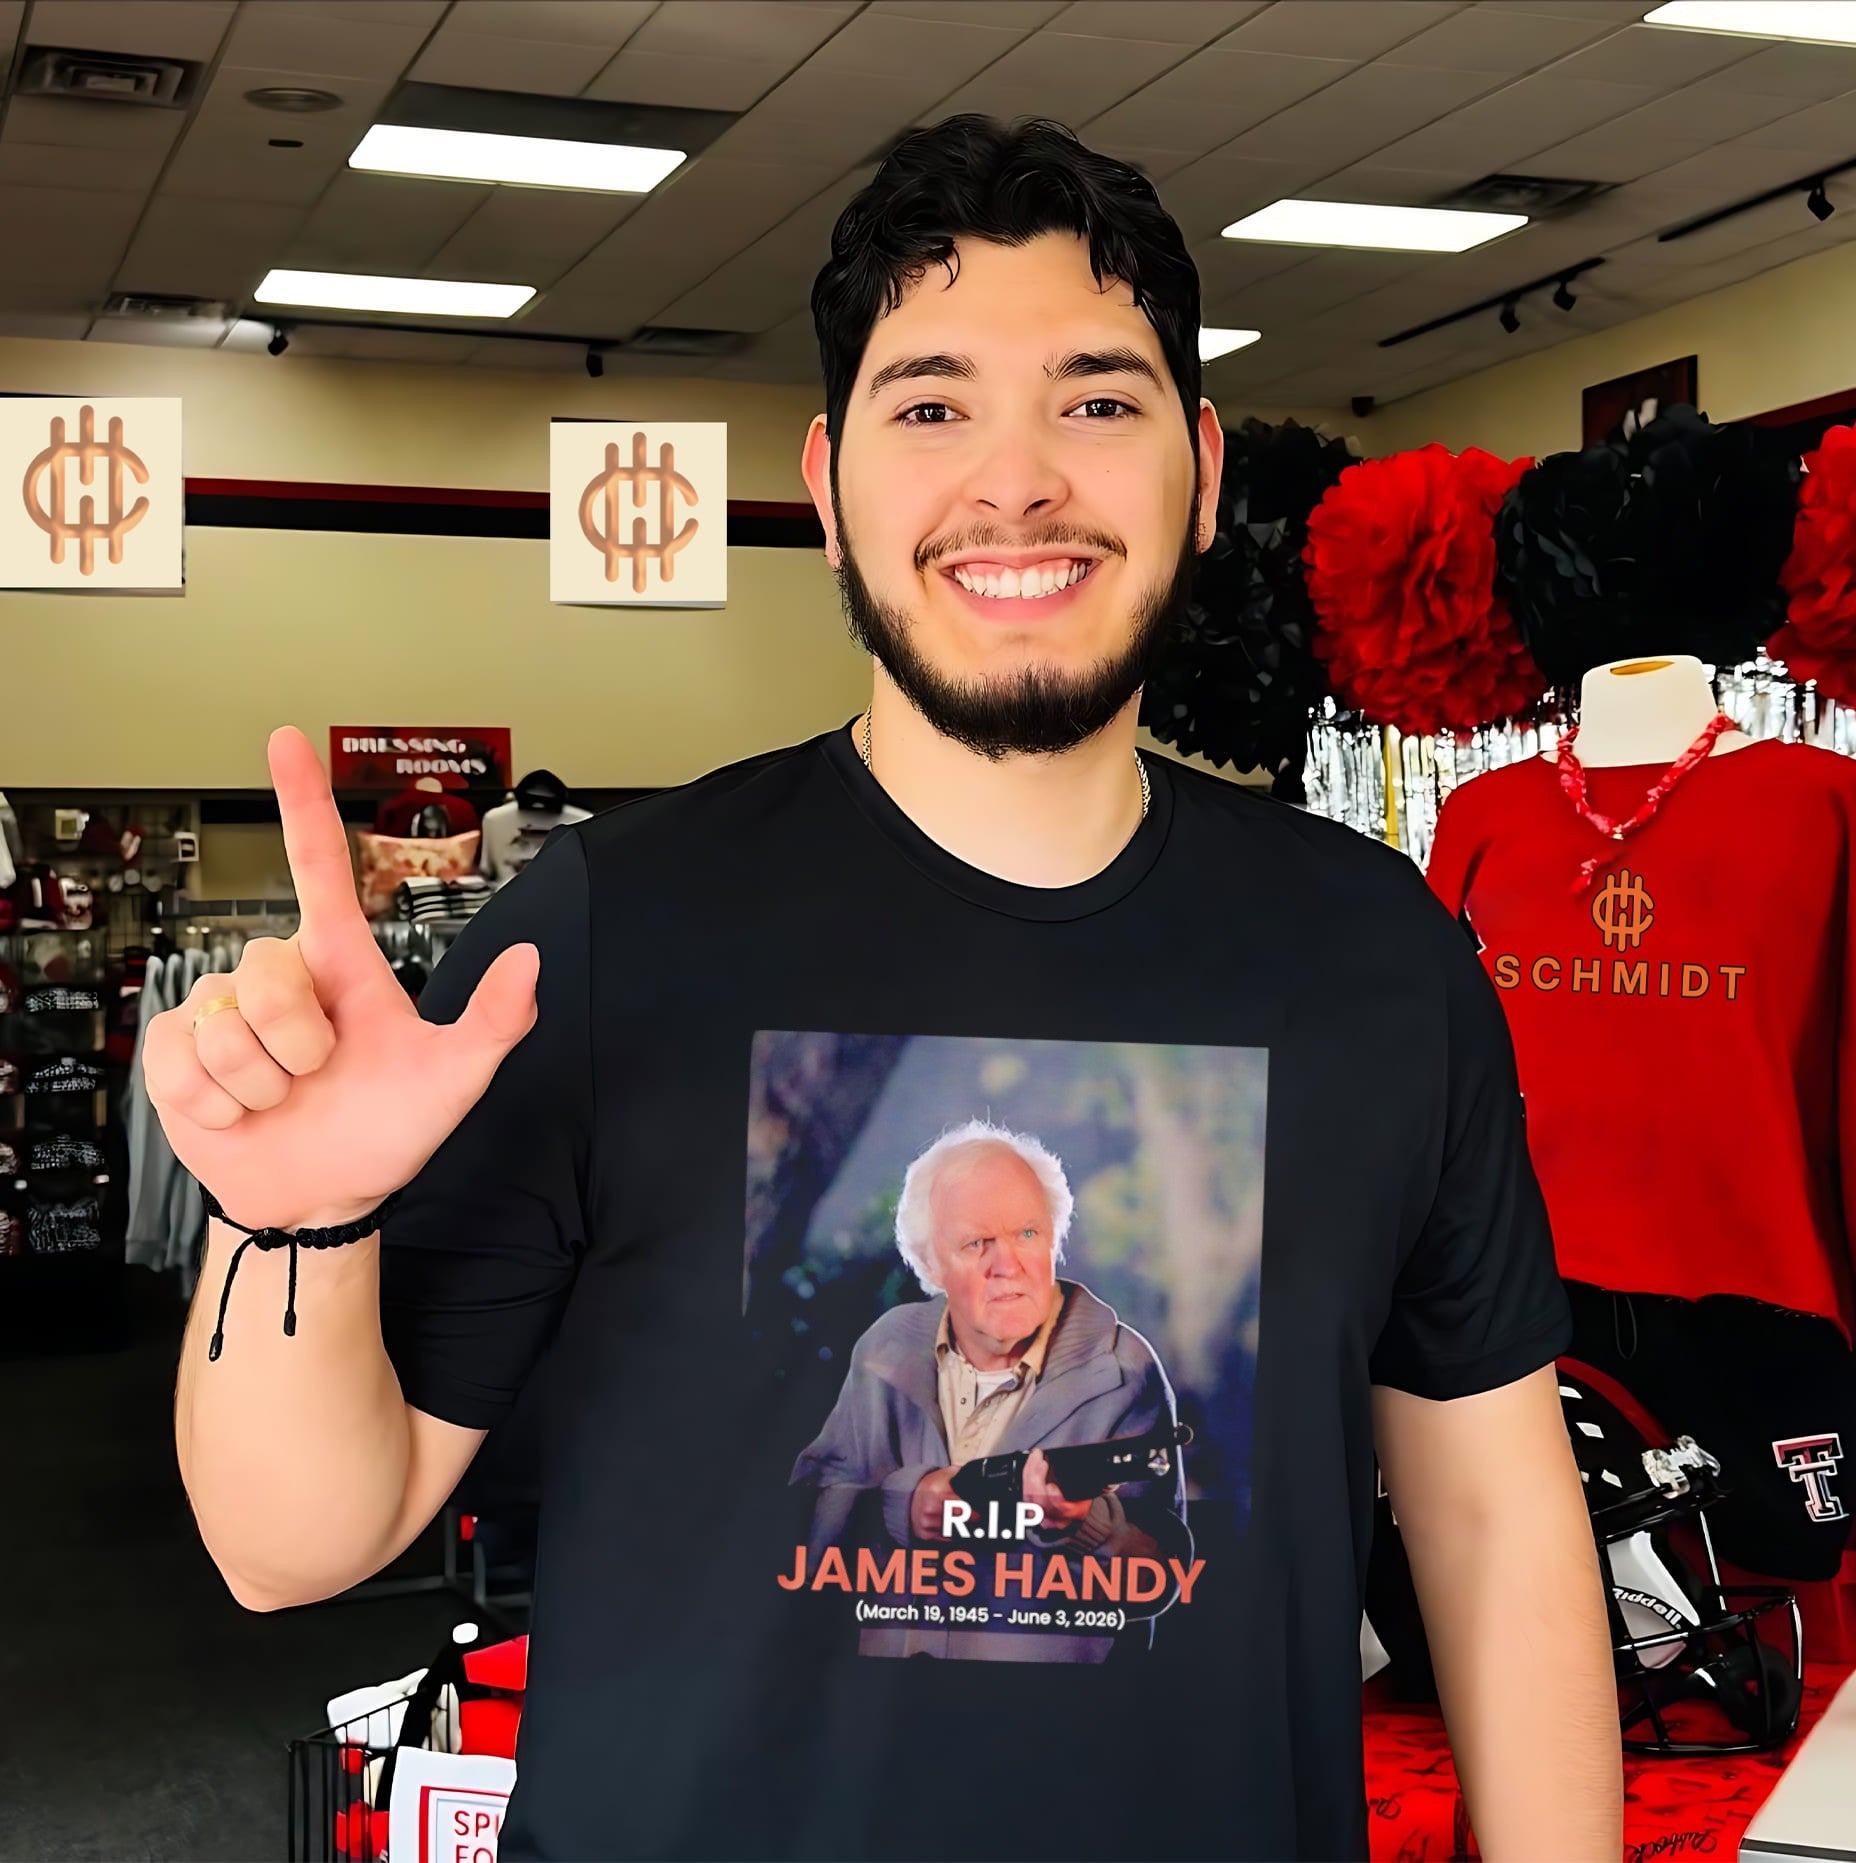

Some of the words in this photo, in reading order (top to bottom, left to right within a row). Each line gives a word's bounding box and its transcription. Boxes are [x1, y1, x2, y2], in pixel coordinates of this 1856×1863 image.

[1493, 953, 1747, 1000] SCHMIDT
[942, 1500, 1045, 1540] R.I.P
[776, 1545, 977, 1597] JAMES
[994, 1552, 1207, 1604] HANDY
[855, 1600, 919, 1621] (March
[923, 1605, 945, 1624] 19,
[949, 1606, 989, 1622] 1945
[1007, 1609, 1052, 1625] June
[1055, 1610, 1071, 1628] 3,
[1074, 1608, 1127, 1631] 2026)
